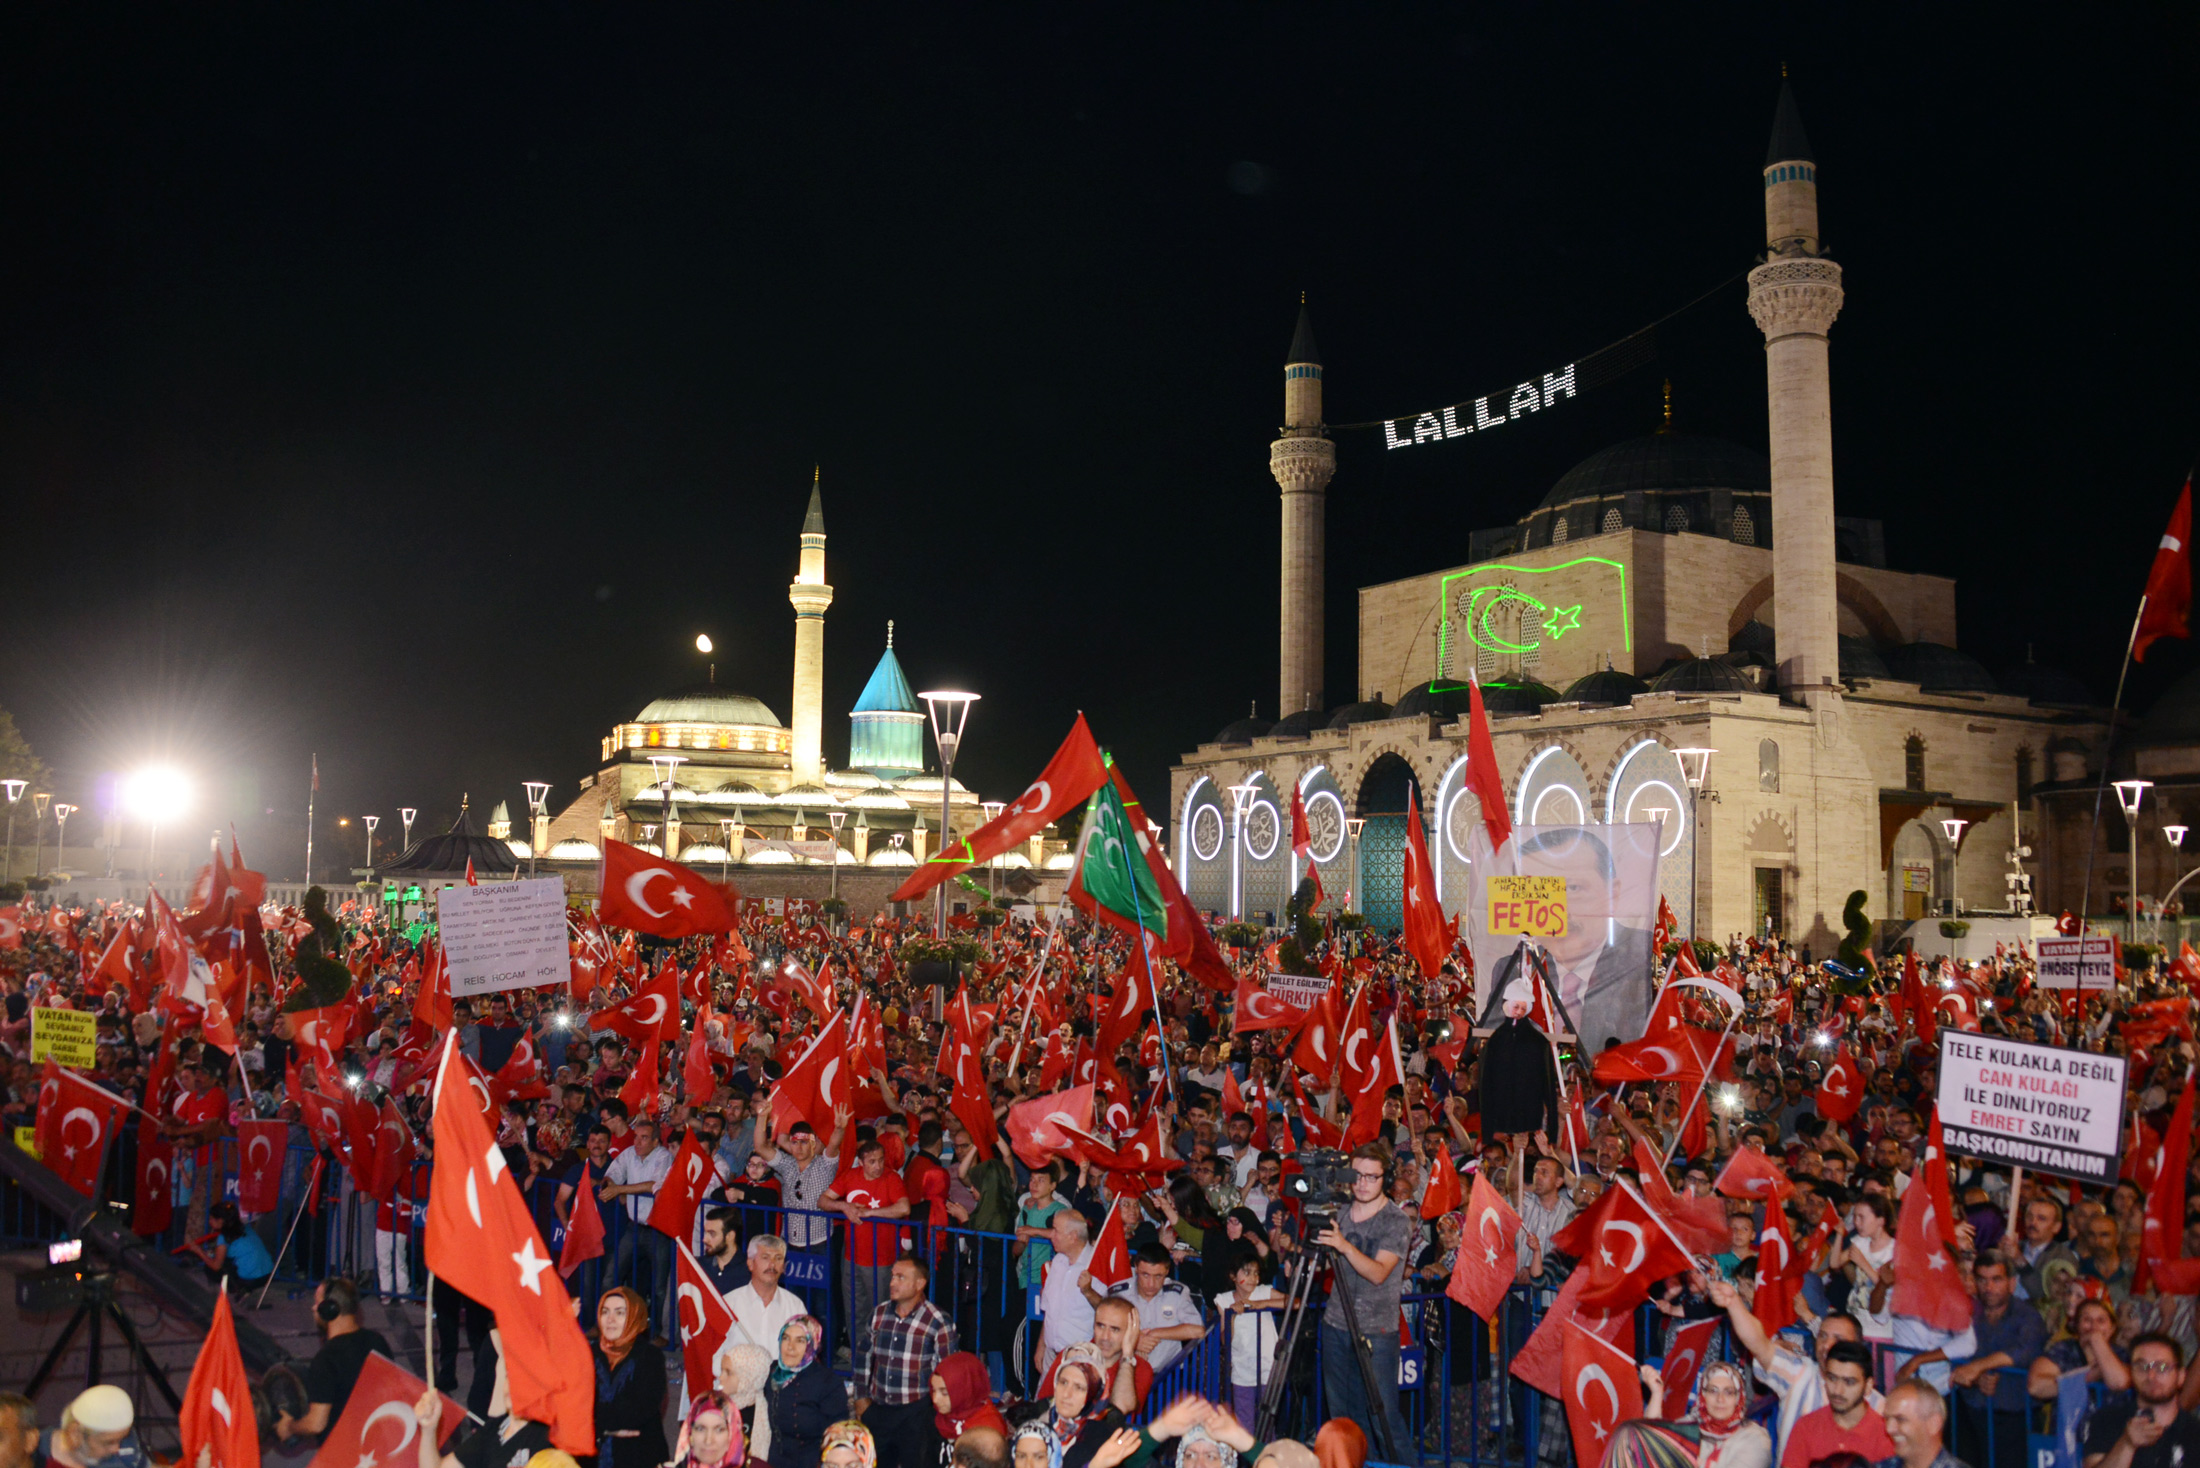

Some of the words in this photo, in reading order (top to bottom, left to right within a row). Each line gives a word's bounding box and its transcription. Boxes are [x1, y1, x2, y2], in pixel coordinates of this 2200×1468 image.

[472, 885, 519, 897] BAŞKANIM
[464, 975, 486, 986] REİS
[491, 970, 526, 982] HOCAM
[1270, 976, 1295, 986] MİLLET
[1296, 978, 1327, 989] EĞİLMEZ
[37, 1010, 72, 1021] VATAN
[1949, 1041, 1983, 1061] TELE
[1989, 1048, 2063, 1074] KULAKLA
[2069, 1060, 2117, 1083] DEĞİL
[1979, 1068, 2013, 1088] CAN
[2018, 1075, 2079, 1099] KULAĞI
[1964, 1084, 1988, 1105] İLE
[1993, 1091, 2091, 1124] DİNLİYORUZ
[1970, 1109, 2025, 1134] EMRET
[2030, 1121, 2080, 1144] SAYIN
[1943, 1128, 2106, 1176] BAŞKOMUTANIM
[784, 1259, 825, 1281] OLİS
